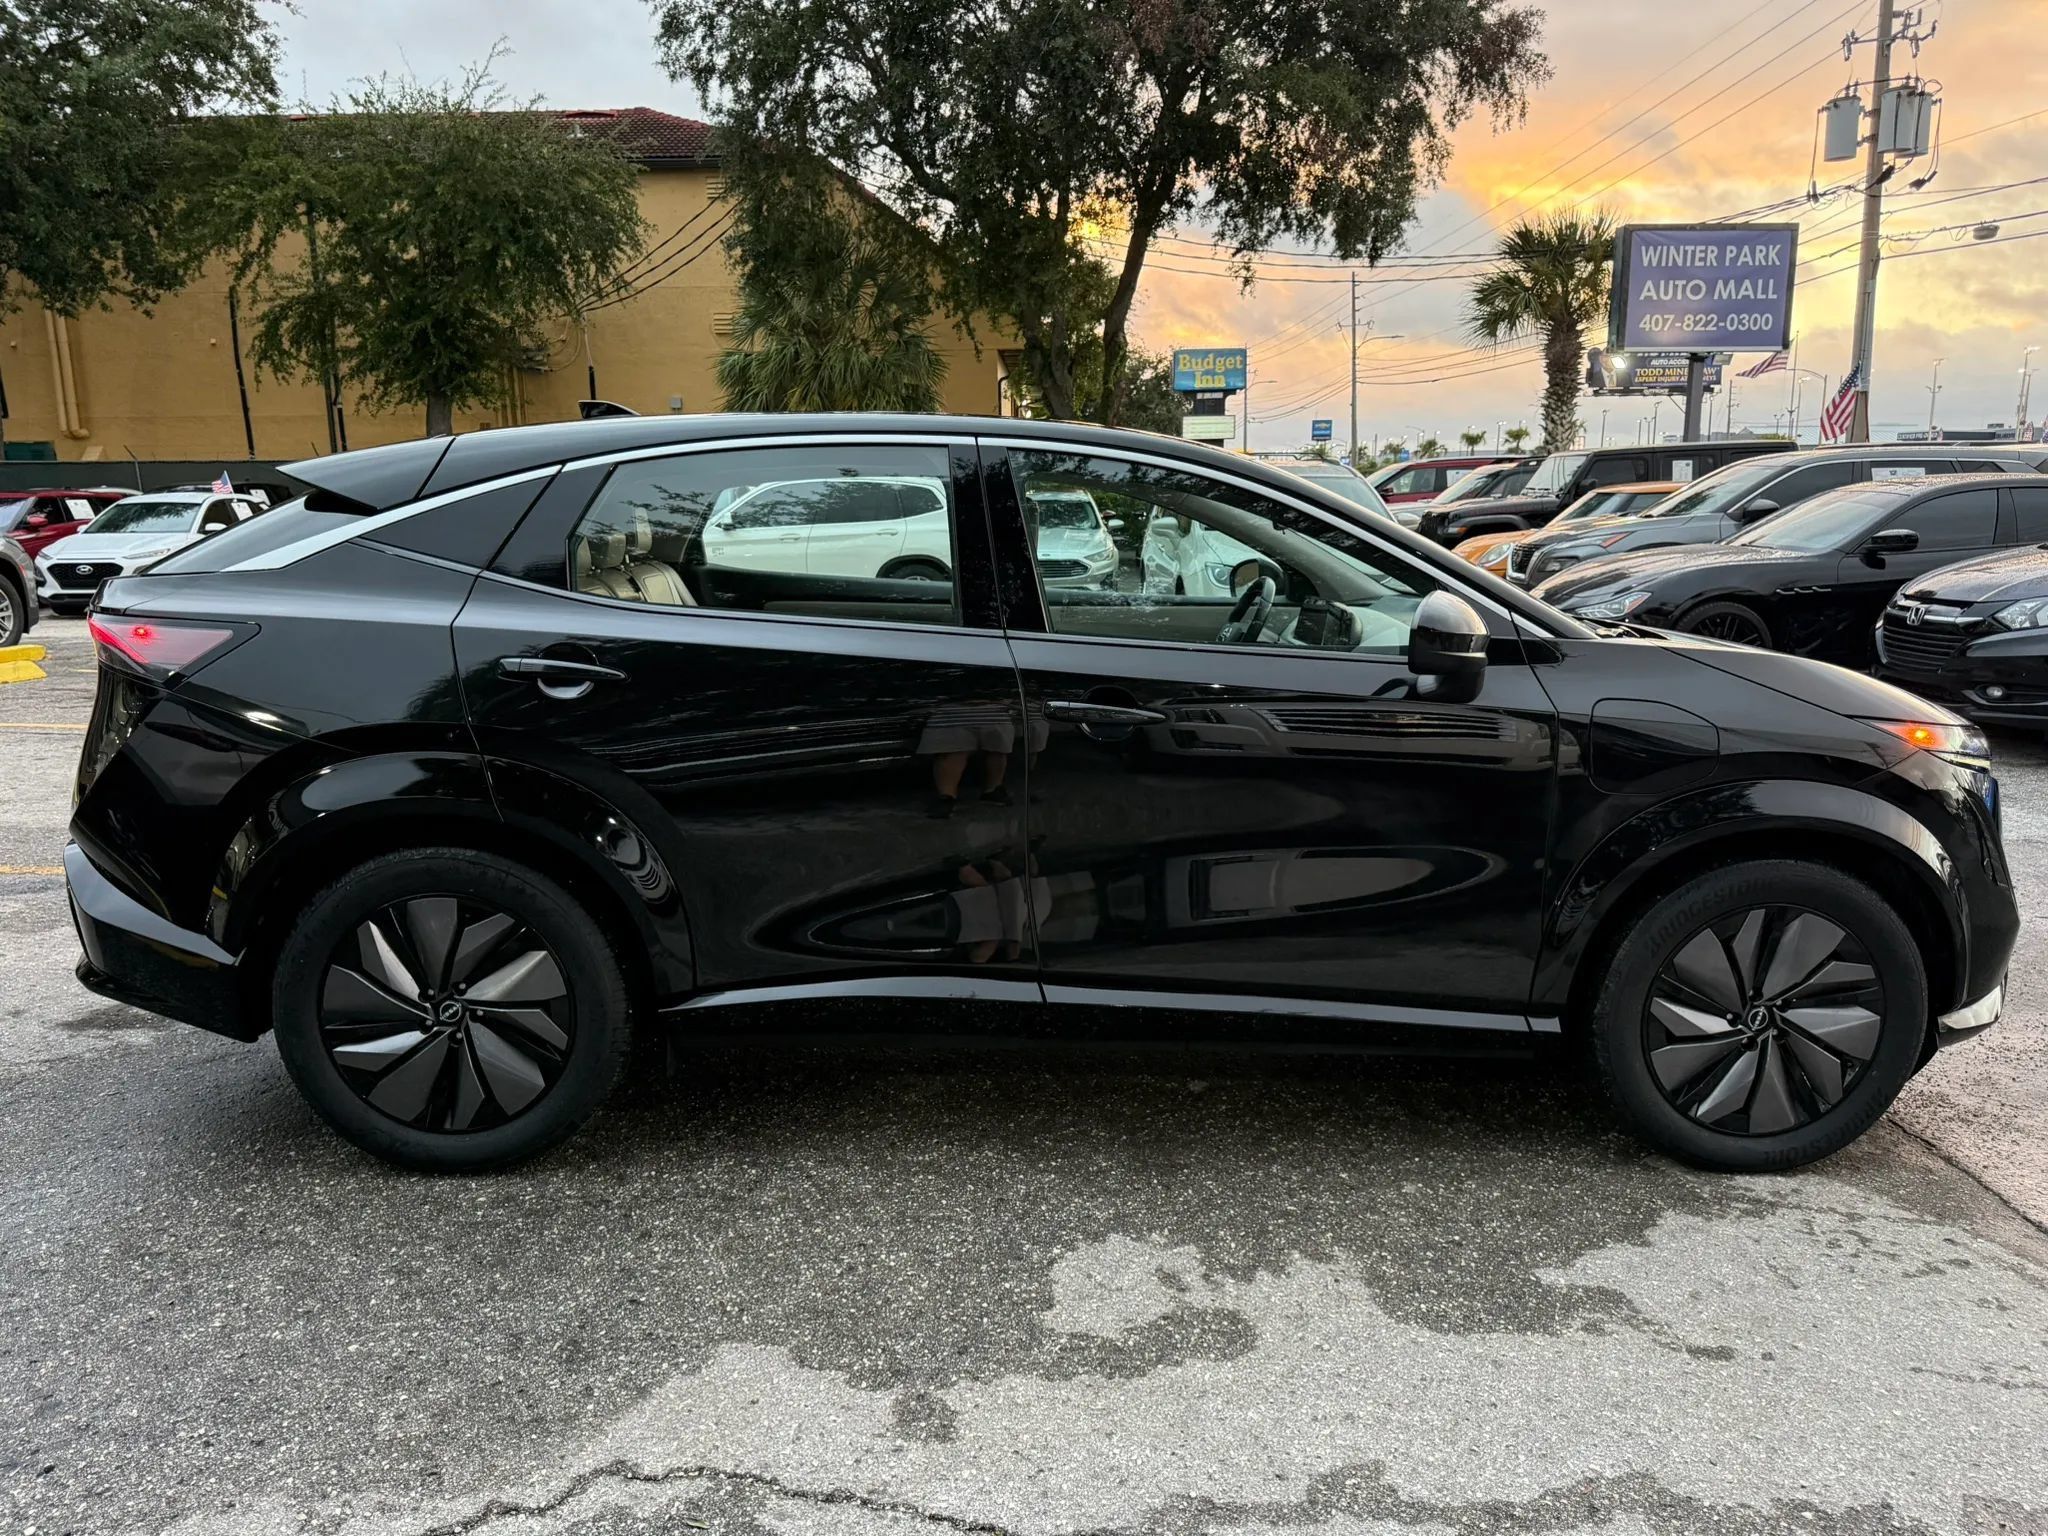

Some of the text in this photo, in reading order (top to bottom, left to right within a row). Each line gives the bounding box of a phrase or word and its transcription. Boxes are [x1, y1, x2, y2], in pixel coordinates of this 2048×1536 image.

[1641, 244, 1781, 267] WINTER PARK
[1639, 278, 1778, 301] AUTO MALL
[1639, 313, 1773, 332] 407-822-0300
[1178, 353, 1243, 373] Budget
[1635, 367, 1664, 377] TODD
[1194, 371, 1226, 388] Inn
